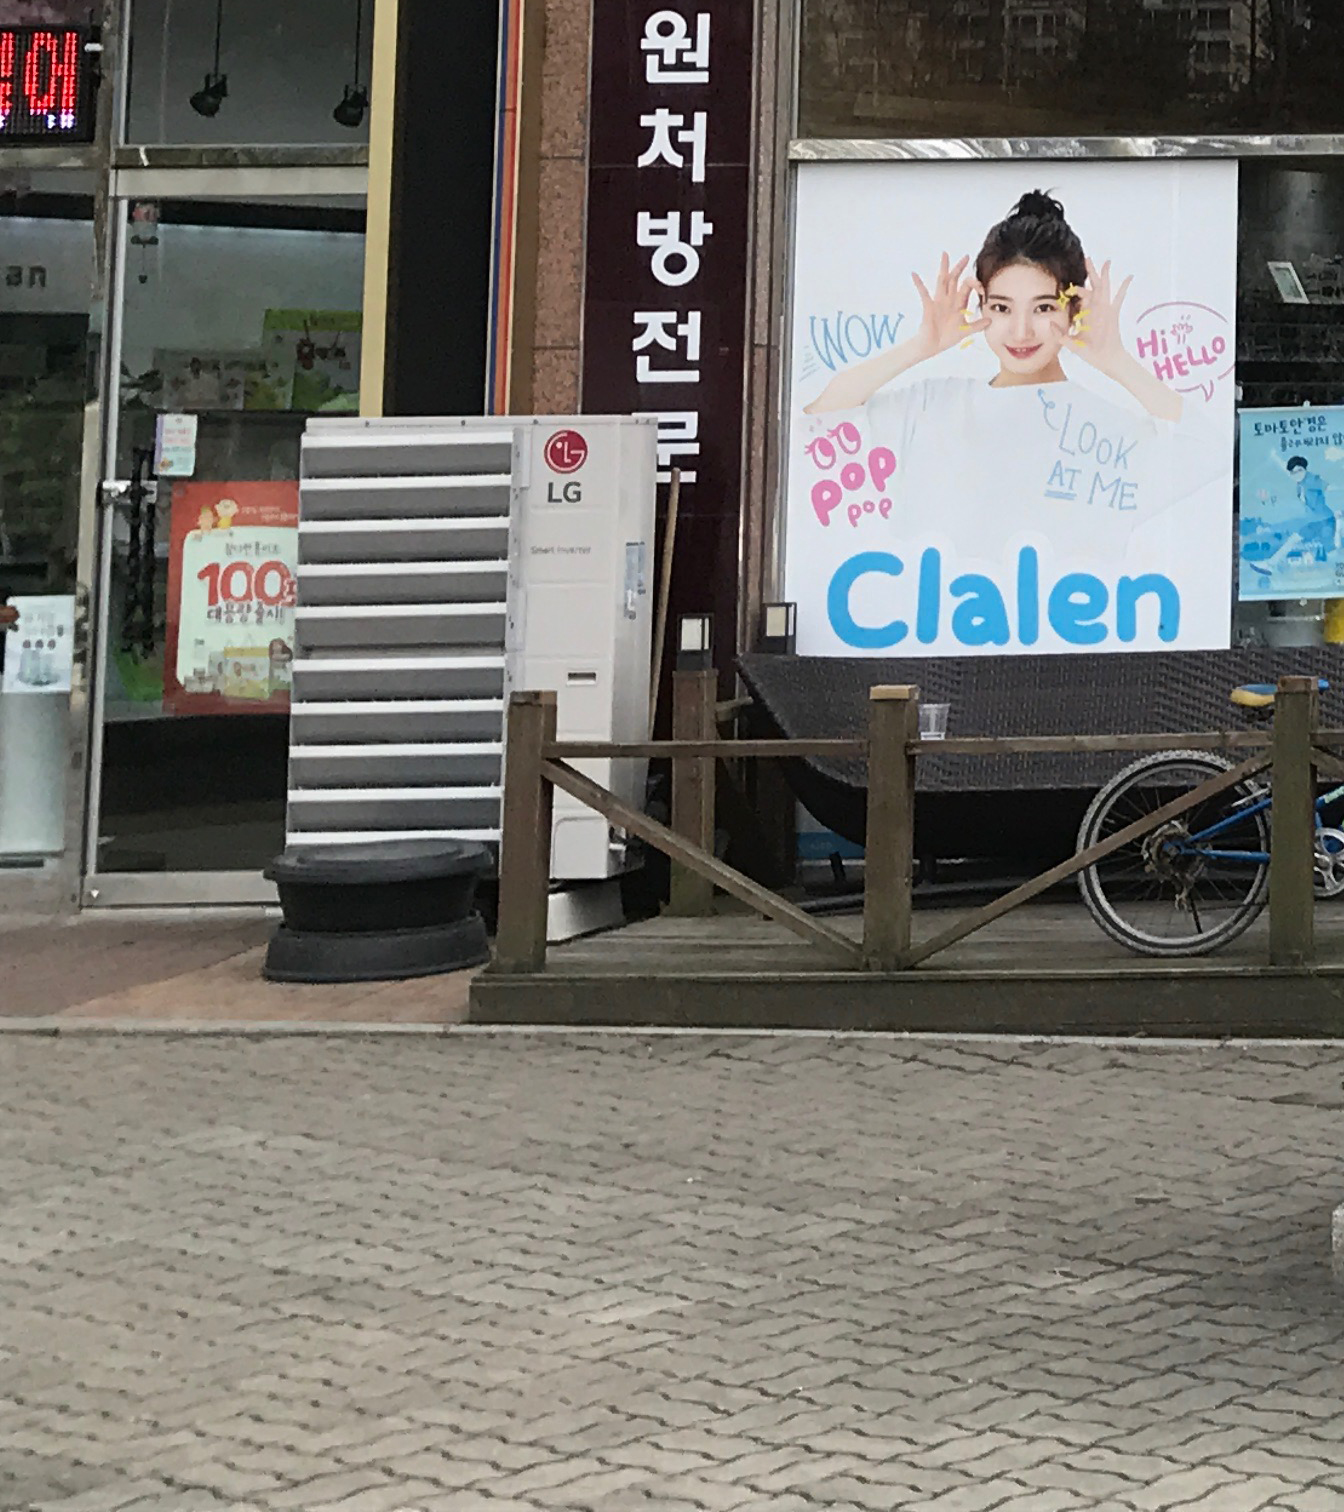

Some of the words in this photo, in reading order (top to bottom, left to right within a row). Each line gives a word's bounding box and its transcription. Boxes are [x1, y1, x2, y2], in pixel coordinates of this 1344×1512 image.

[810, 310, 904, 371] WOW
[1136, 330, 1168, 358] Hi
[1154, 336, 1227, 381] HELLO
[547, 481, 582, 504] LG
[811, 446, 897, 527] POP
[1047, 460, 1082, 491] AT
[1088, 472, 1139, 511] ME
[827, 545, 1181, 649] Clalen
